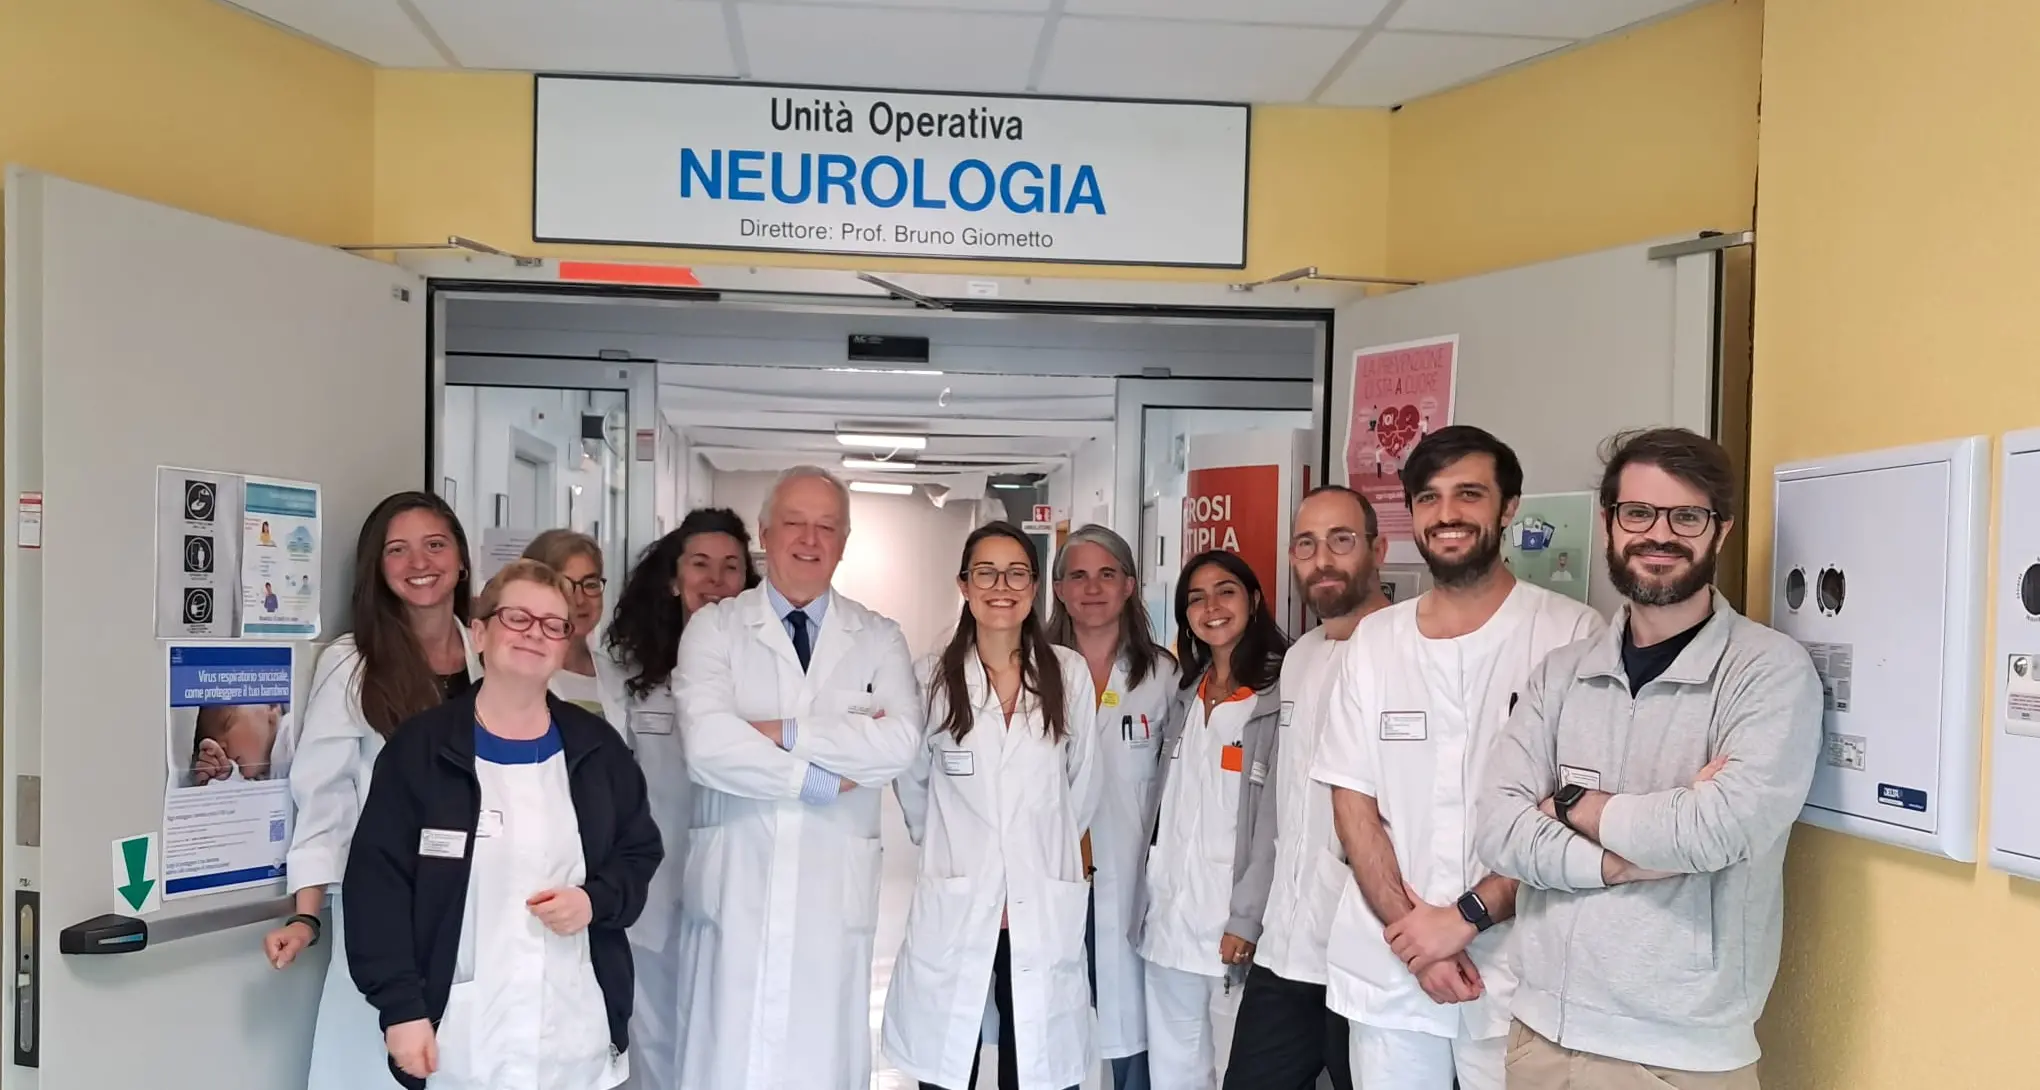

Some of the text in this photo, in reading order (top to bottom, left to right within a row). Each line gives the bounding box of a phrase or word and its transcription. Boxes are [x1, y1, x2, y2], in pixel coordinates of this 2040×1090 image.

[770, 97, 1023, 143] Unità Operativa
[680, 147, 1106, 215] NEUROLOGIA
[740, 218, 1054, 249] Direttore: Prof. Bruno Giometto
[184, 687, 204, 699] come
[205, 685, 242, 701] proteggere
[249, 685, 260, 697] tuo
[261, 683, 289, 697] bambino
[198, 669, 217, 683] Virus
[218, 669, 257, 685] respiratorio
